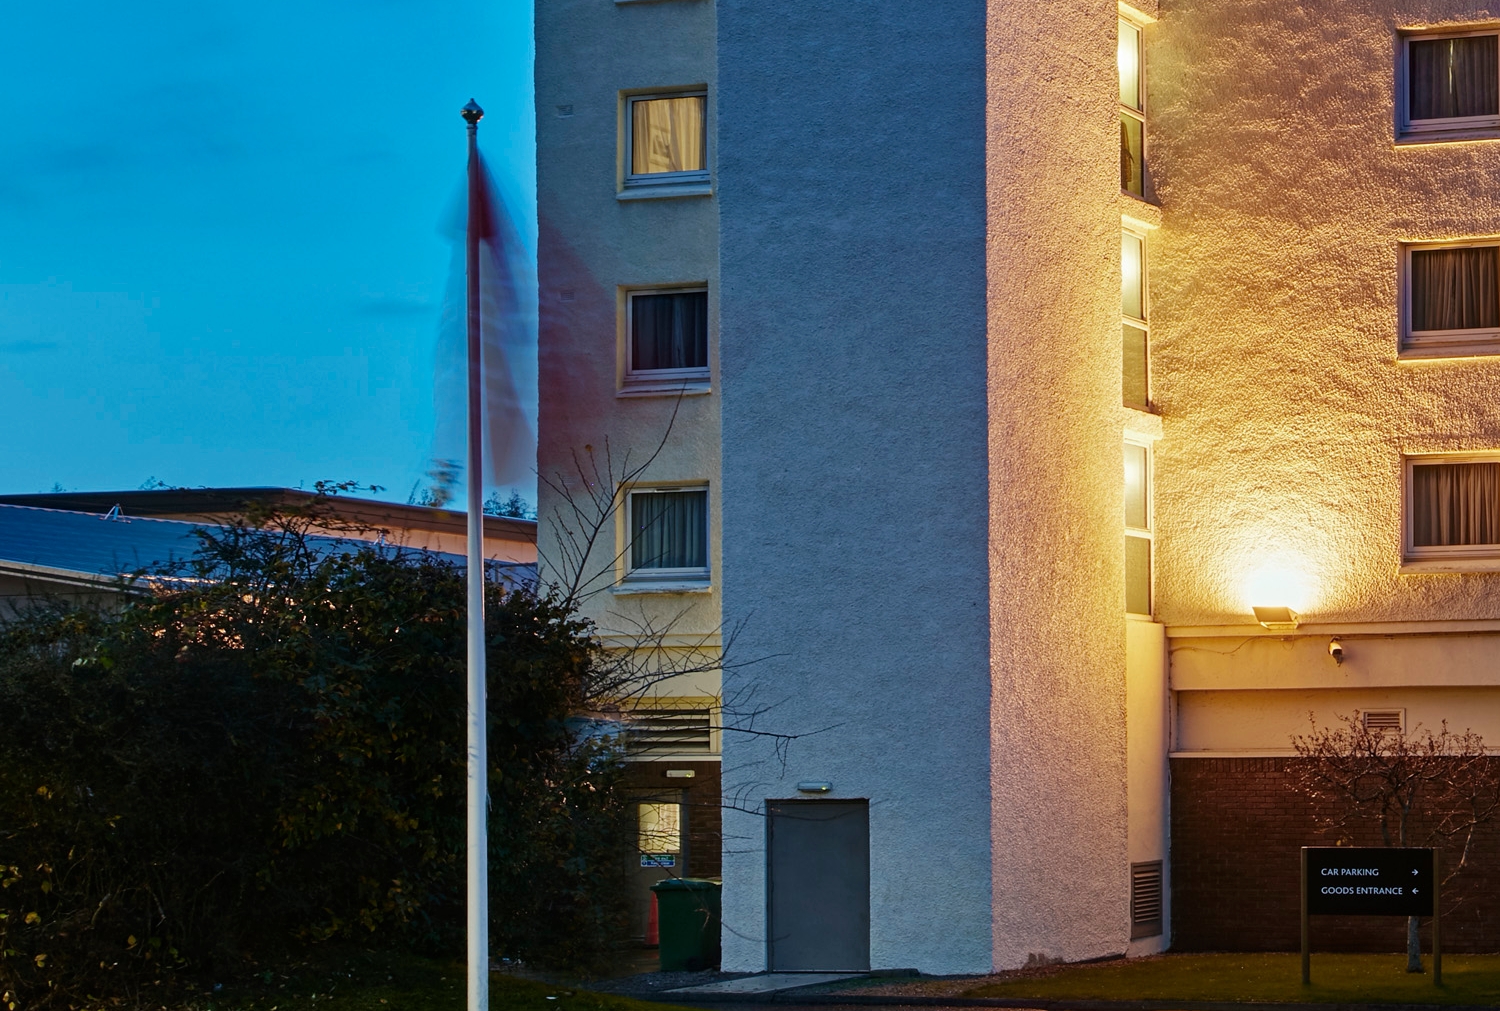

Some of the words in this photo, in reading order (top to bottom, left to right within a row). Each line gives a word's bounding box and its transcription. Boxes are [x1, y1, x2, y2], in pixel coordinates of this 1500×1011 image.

[1321, 868, 1339, 876] CAR
[1341, 868, 1379, 876] PARKING
[1321, 886, 1354, 895] GOODS
[1356, 887, 1403, 895] ENTRANCE
